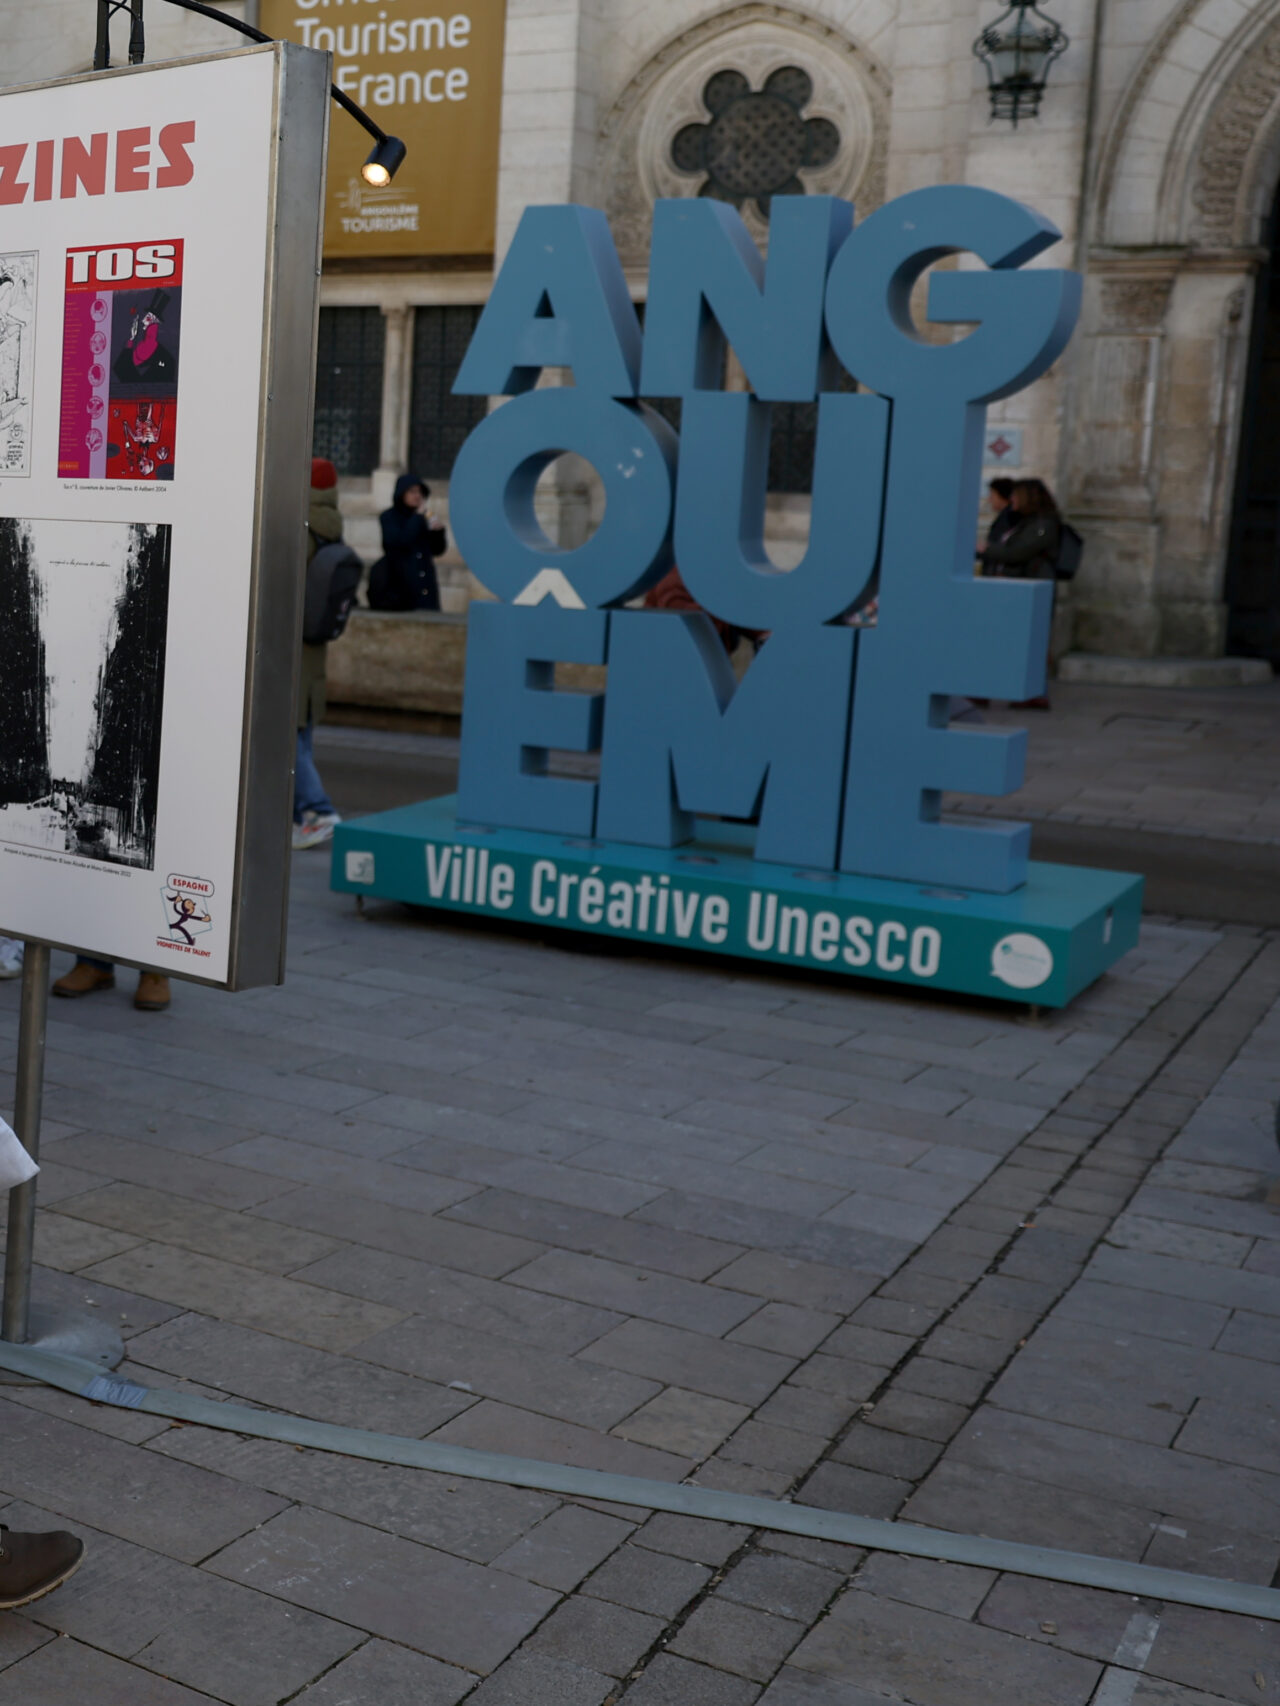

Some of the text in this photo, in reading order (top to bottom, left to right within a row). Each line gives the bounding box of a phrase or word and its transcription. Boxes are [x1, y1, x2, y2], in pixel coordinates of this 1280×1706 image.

[294, 11, 470, 56] Tourisme
[336, 66, 469, 108] France
[341, 215, 419, 233] TOURISME
[66, 244, 176, 284] TOS
[173, 878, 209, 892] ESPAGNE
[424, 844, 942, 978] Ville Créative Unesco
[156, 940, 183, 953] VIGNETTES
[192, 947, 211, 957] TALENT
